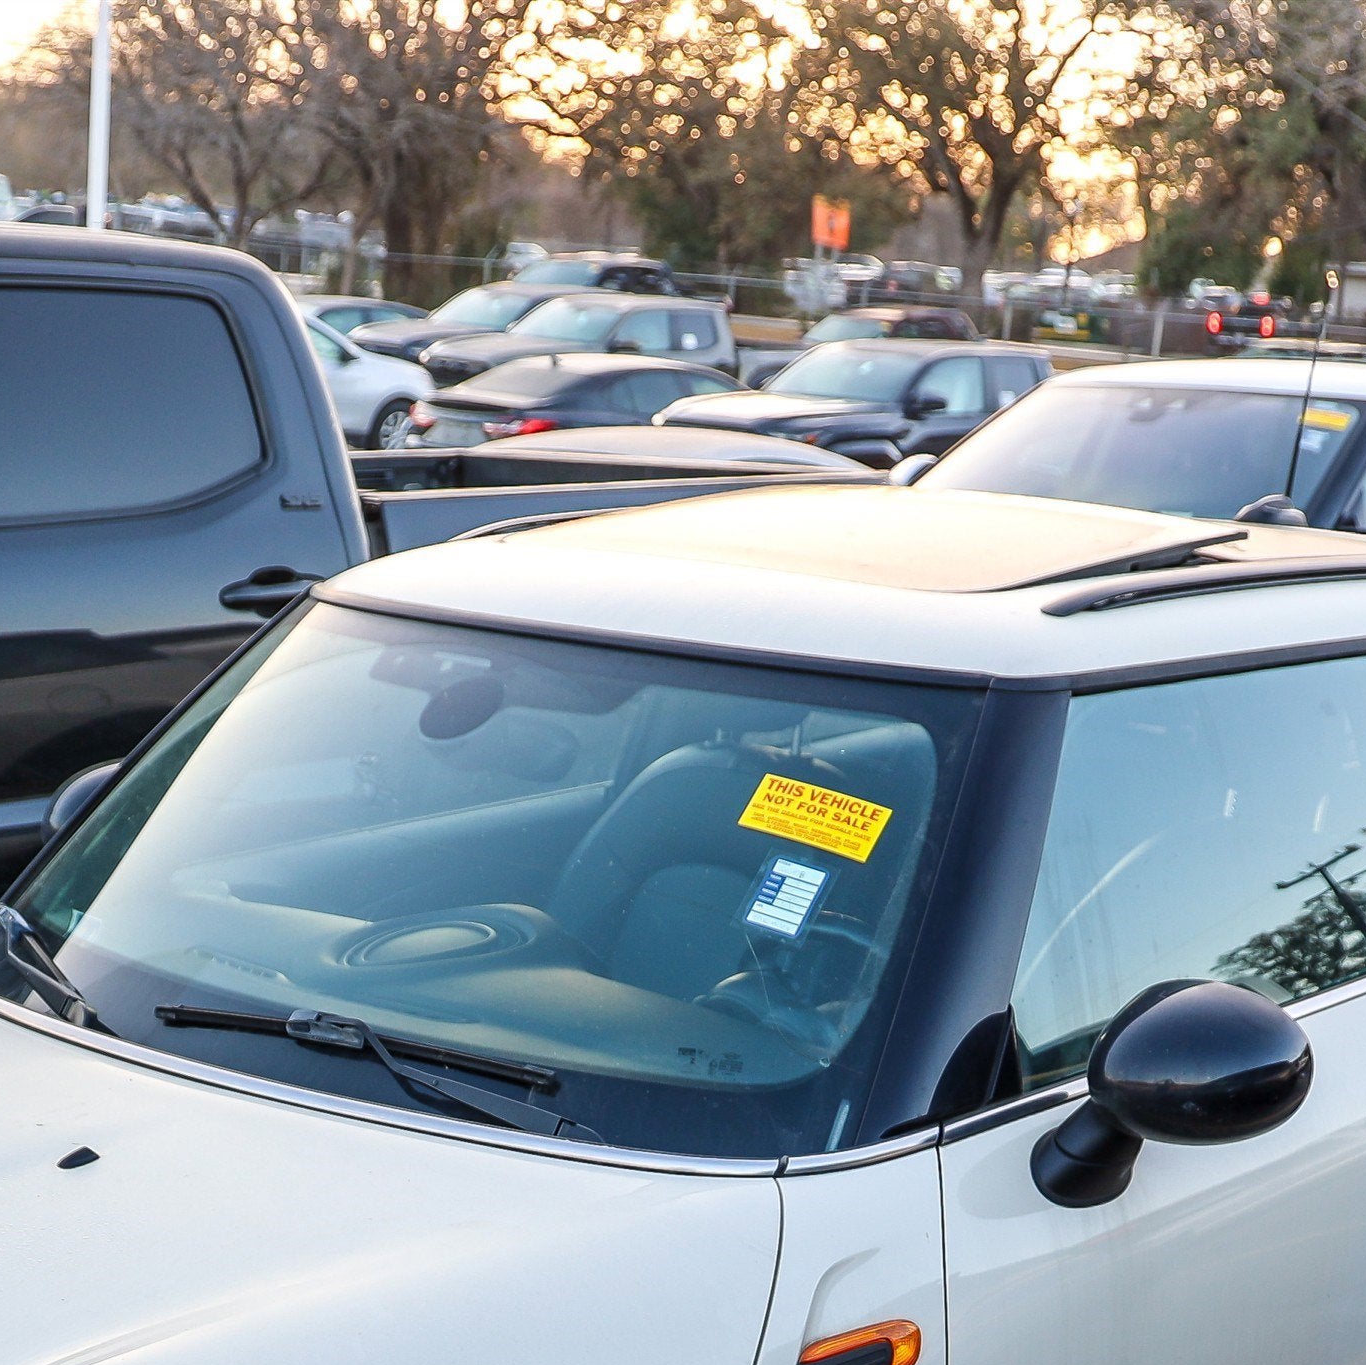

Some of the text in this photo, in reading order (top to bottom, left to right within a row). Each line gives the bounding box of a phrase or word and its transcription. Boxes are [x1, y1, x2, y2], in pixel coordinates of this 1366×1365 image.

[763, 792, 873, 832] NOT FOR SALE
[767, 777, 884, 821] THIS VEHICLE
